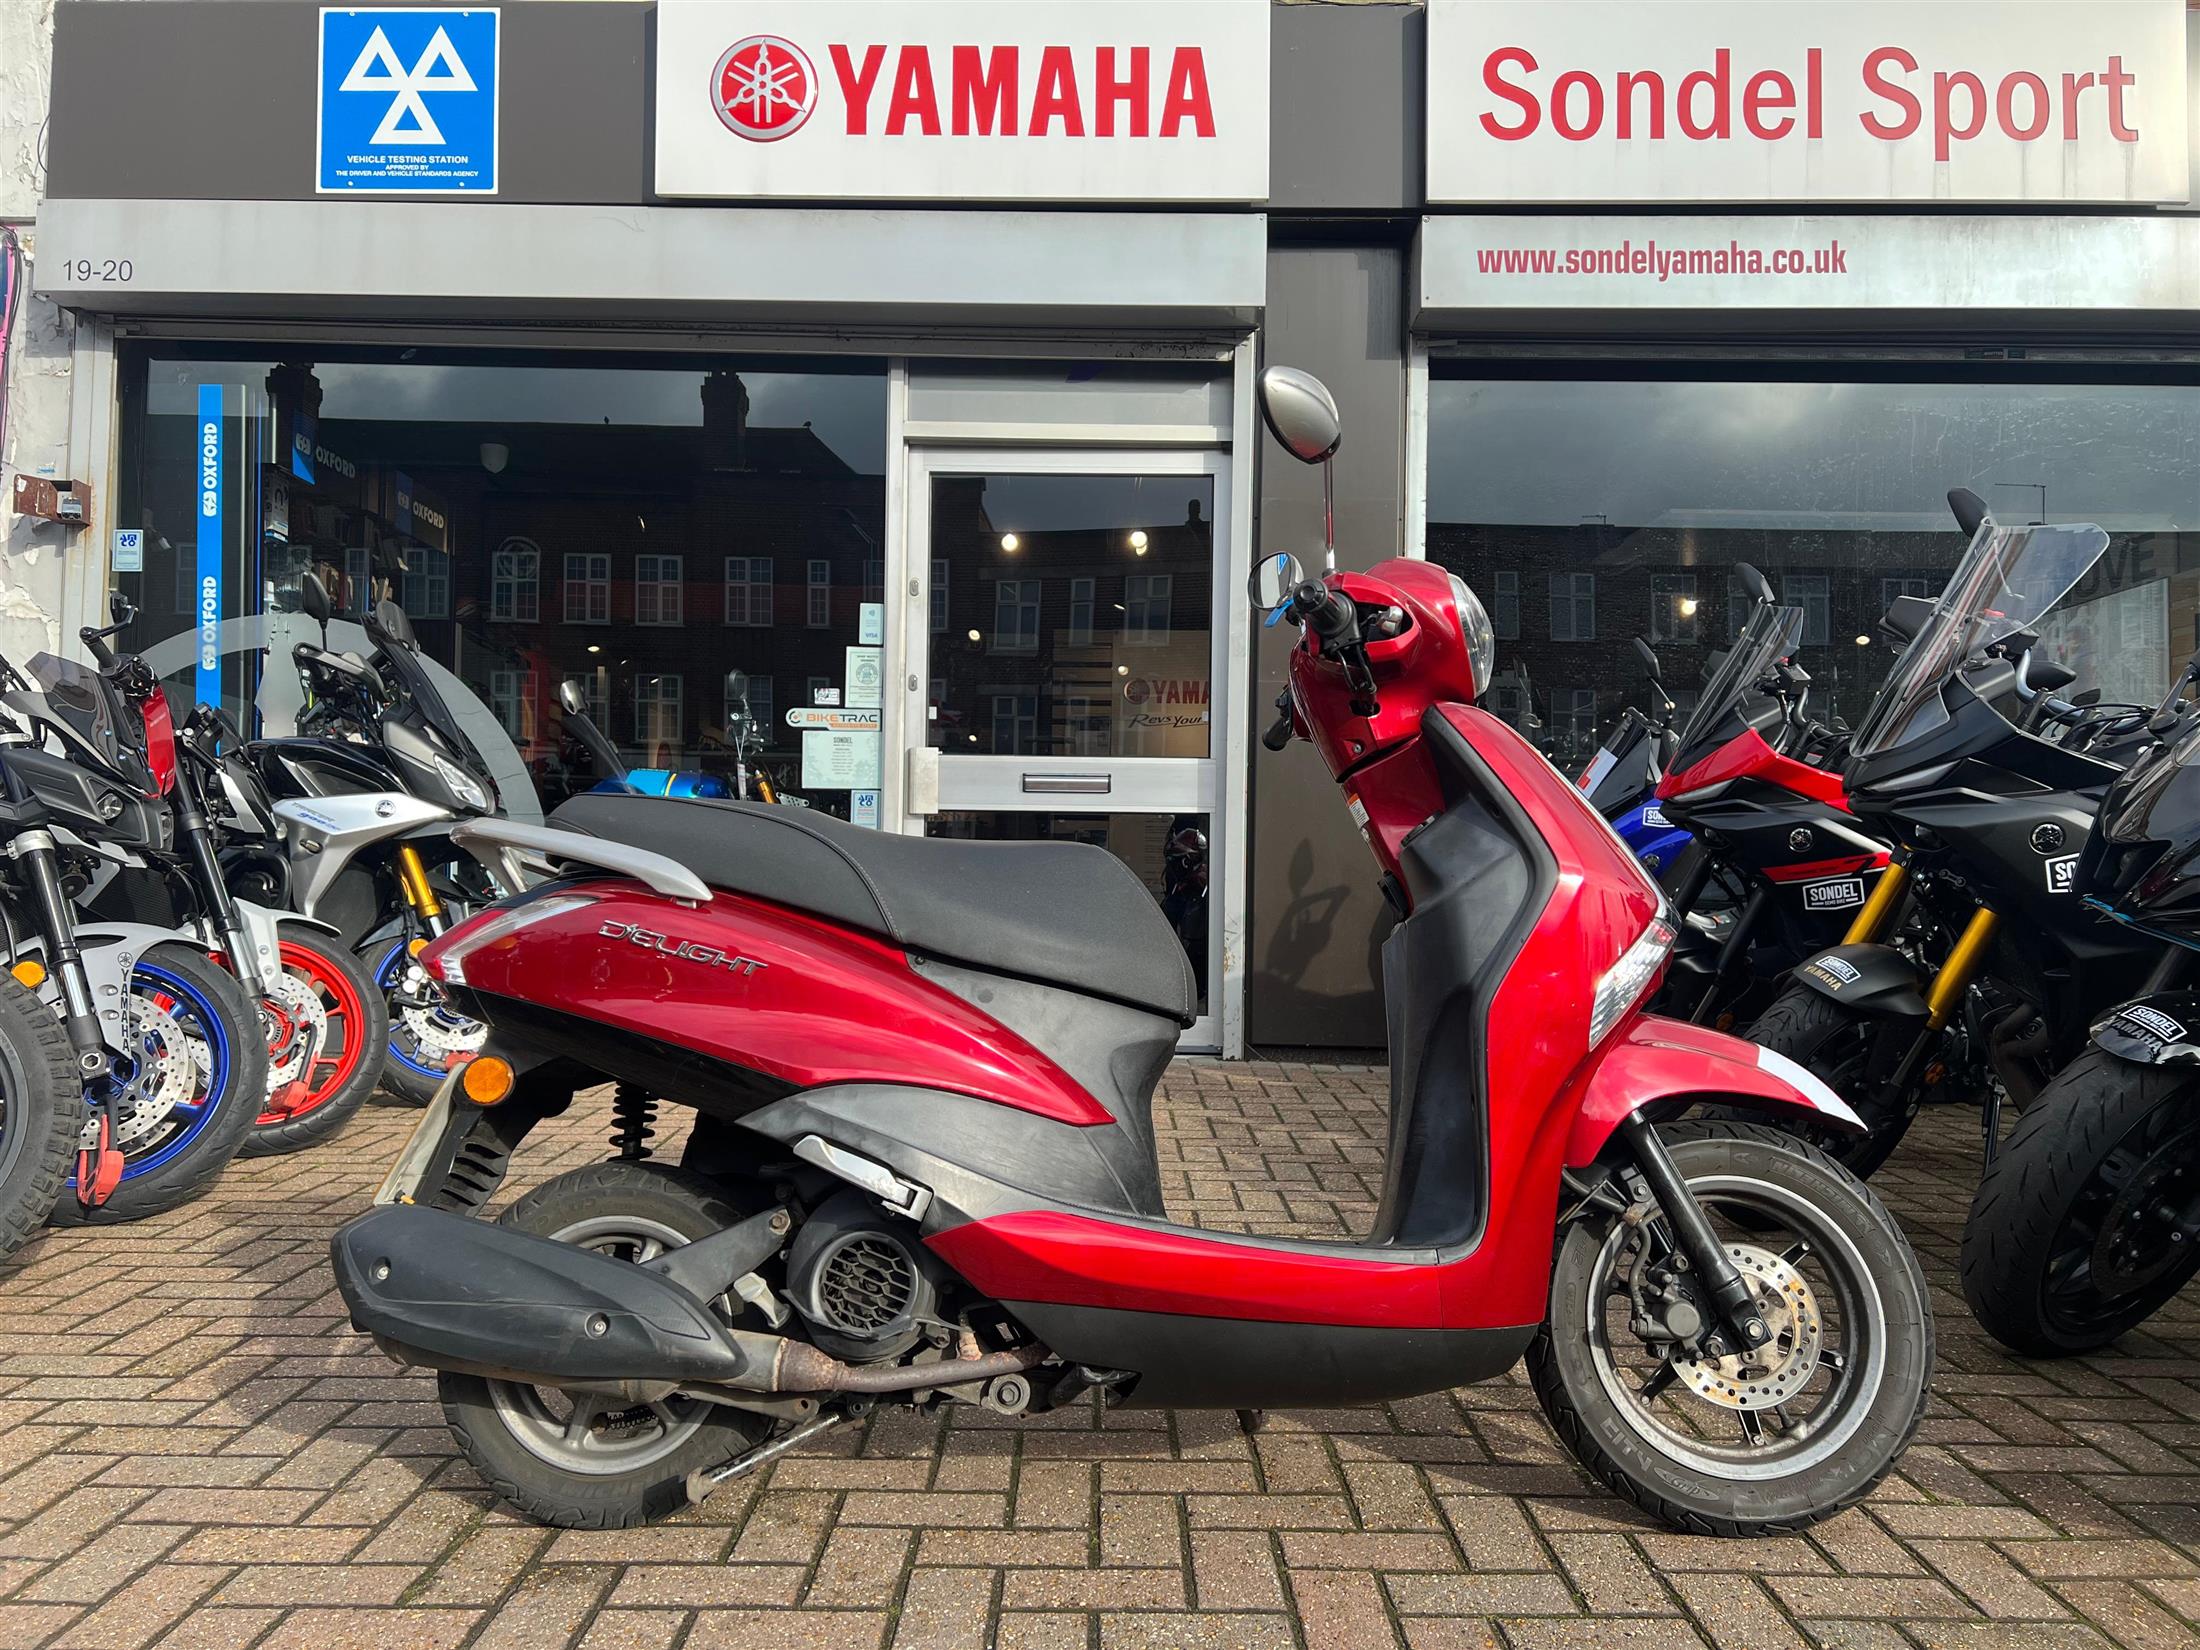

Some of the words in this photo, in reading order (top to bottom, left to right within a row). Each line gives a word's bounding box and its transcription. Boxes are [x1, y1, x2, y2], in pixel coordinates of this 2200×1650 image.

[828, 44, 1216, 137] YAMAHA
[1478, 46, 1823, 140] Sondel
[1859, 46, 2140, 162] Sport
[347, 155, 386, 164] VEHICLE
[387, 155, 427, 164] TESTING
[429, 155, 469, 164] STATION
[62, 259, 134, 283] 19-20
[1477, 240, 1847, 283] www.sondelyamaha.co.uk
[203, 422, 218, 490] OXFORD
[315, 445, 356, 480] OXFORD
[412, 501, 445, 530] OXFORD
[202, 575, 217, 644] OXFORD
[1809, 882, 1858, 902] SONDEL
[1803, 965, 1842, 991] YAMAHA
[1823, 957, 1855, 979] SONDEL
[120, 968, 130, 1052] YAMAHA
[2132, 1007, 2178, 1035] SONDEL
